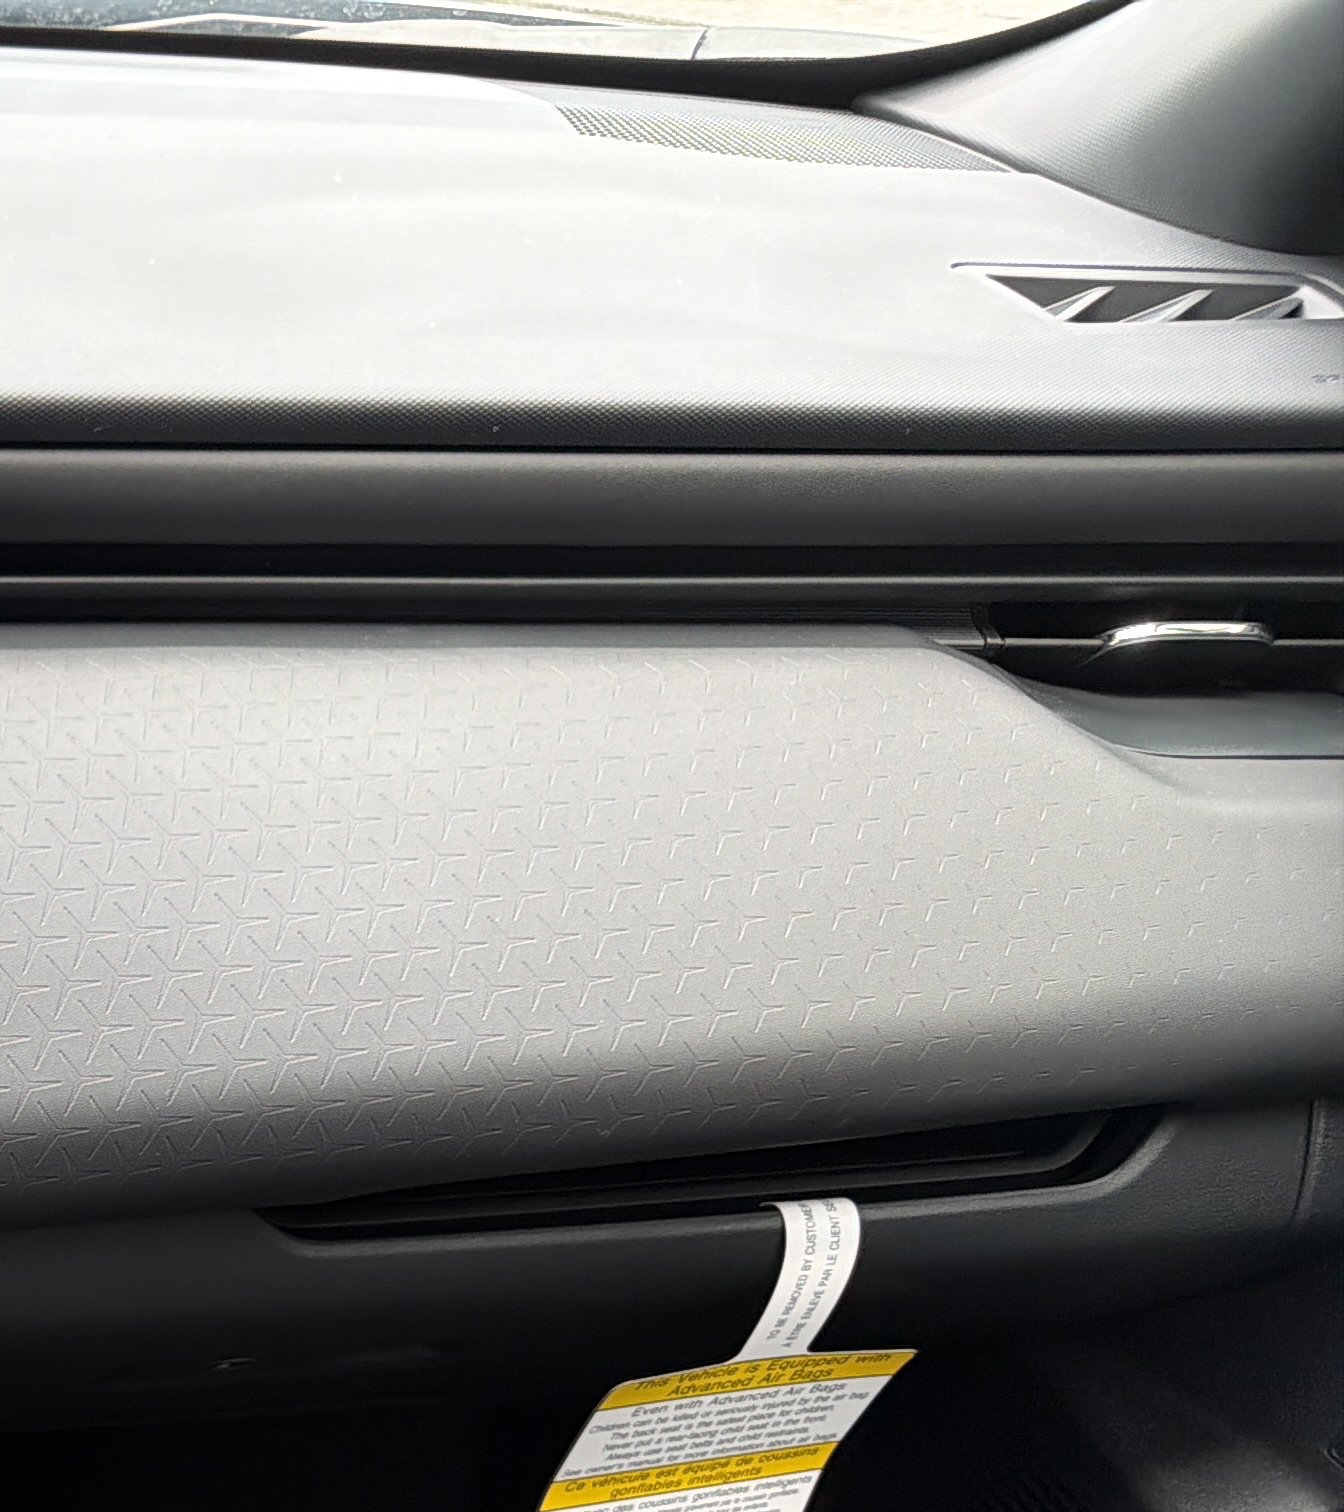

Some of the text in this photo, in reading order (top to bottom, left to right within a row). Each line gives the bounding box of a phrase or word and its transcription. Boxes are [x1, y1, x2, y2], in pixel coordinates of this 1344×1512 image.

[829, 1215, 841, 1251] CLIENT
[827, 1254, 838, 1268] LE
[782, 1274, 808, 1316] REMOVED
[801, 1258, 812, 1272] BY
[818, 1268, 834, 1287] PAR
[668, 1366, 835, 1397] Advanced Air Bags
[678, 1366, 739, 1383] Vehicle
[744, 1362, 760, 1374] is
[766, 1354, 851, 1371] Equipped
[855, 1353, 892, 1365] with
[632, 1404, 668, 1417] Even
[674, 1401, 702, 1410] with
[709, 1389, 778, 1406] Advanced
[808, 1382, 845, 1395] Bags
[564, 1483, 585, 1492] Ce
[655, 1469, 677, 1478] est
[733, 1458, 752, 1467] de
